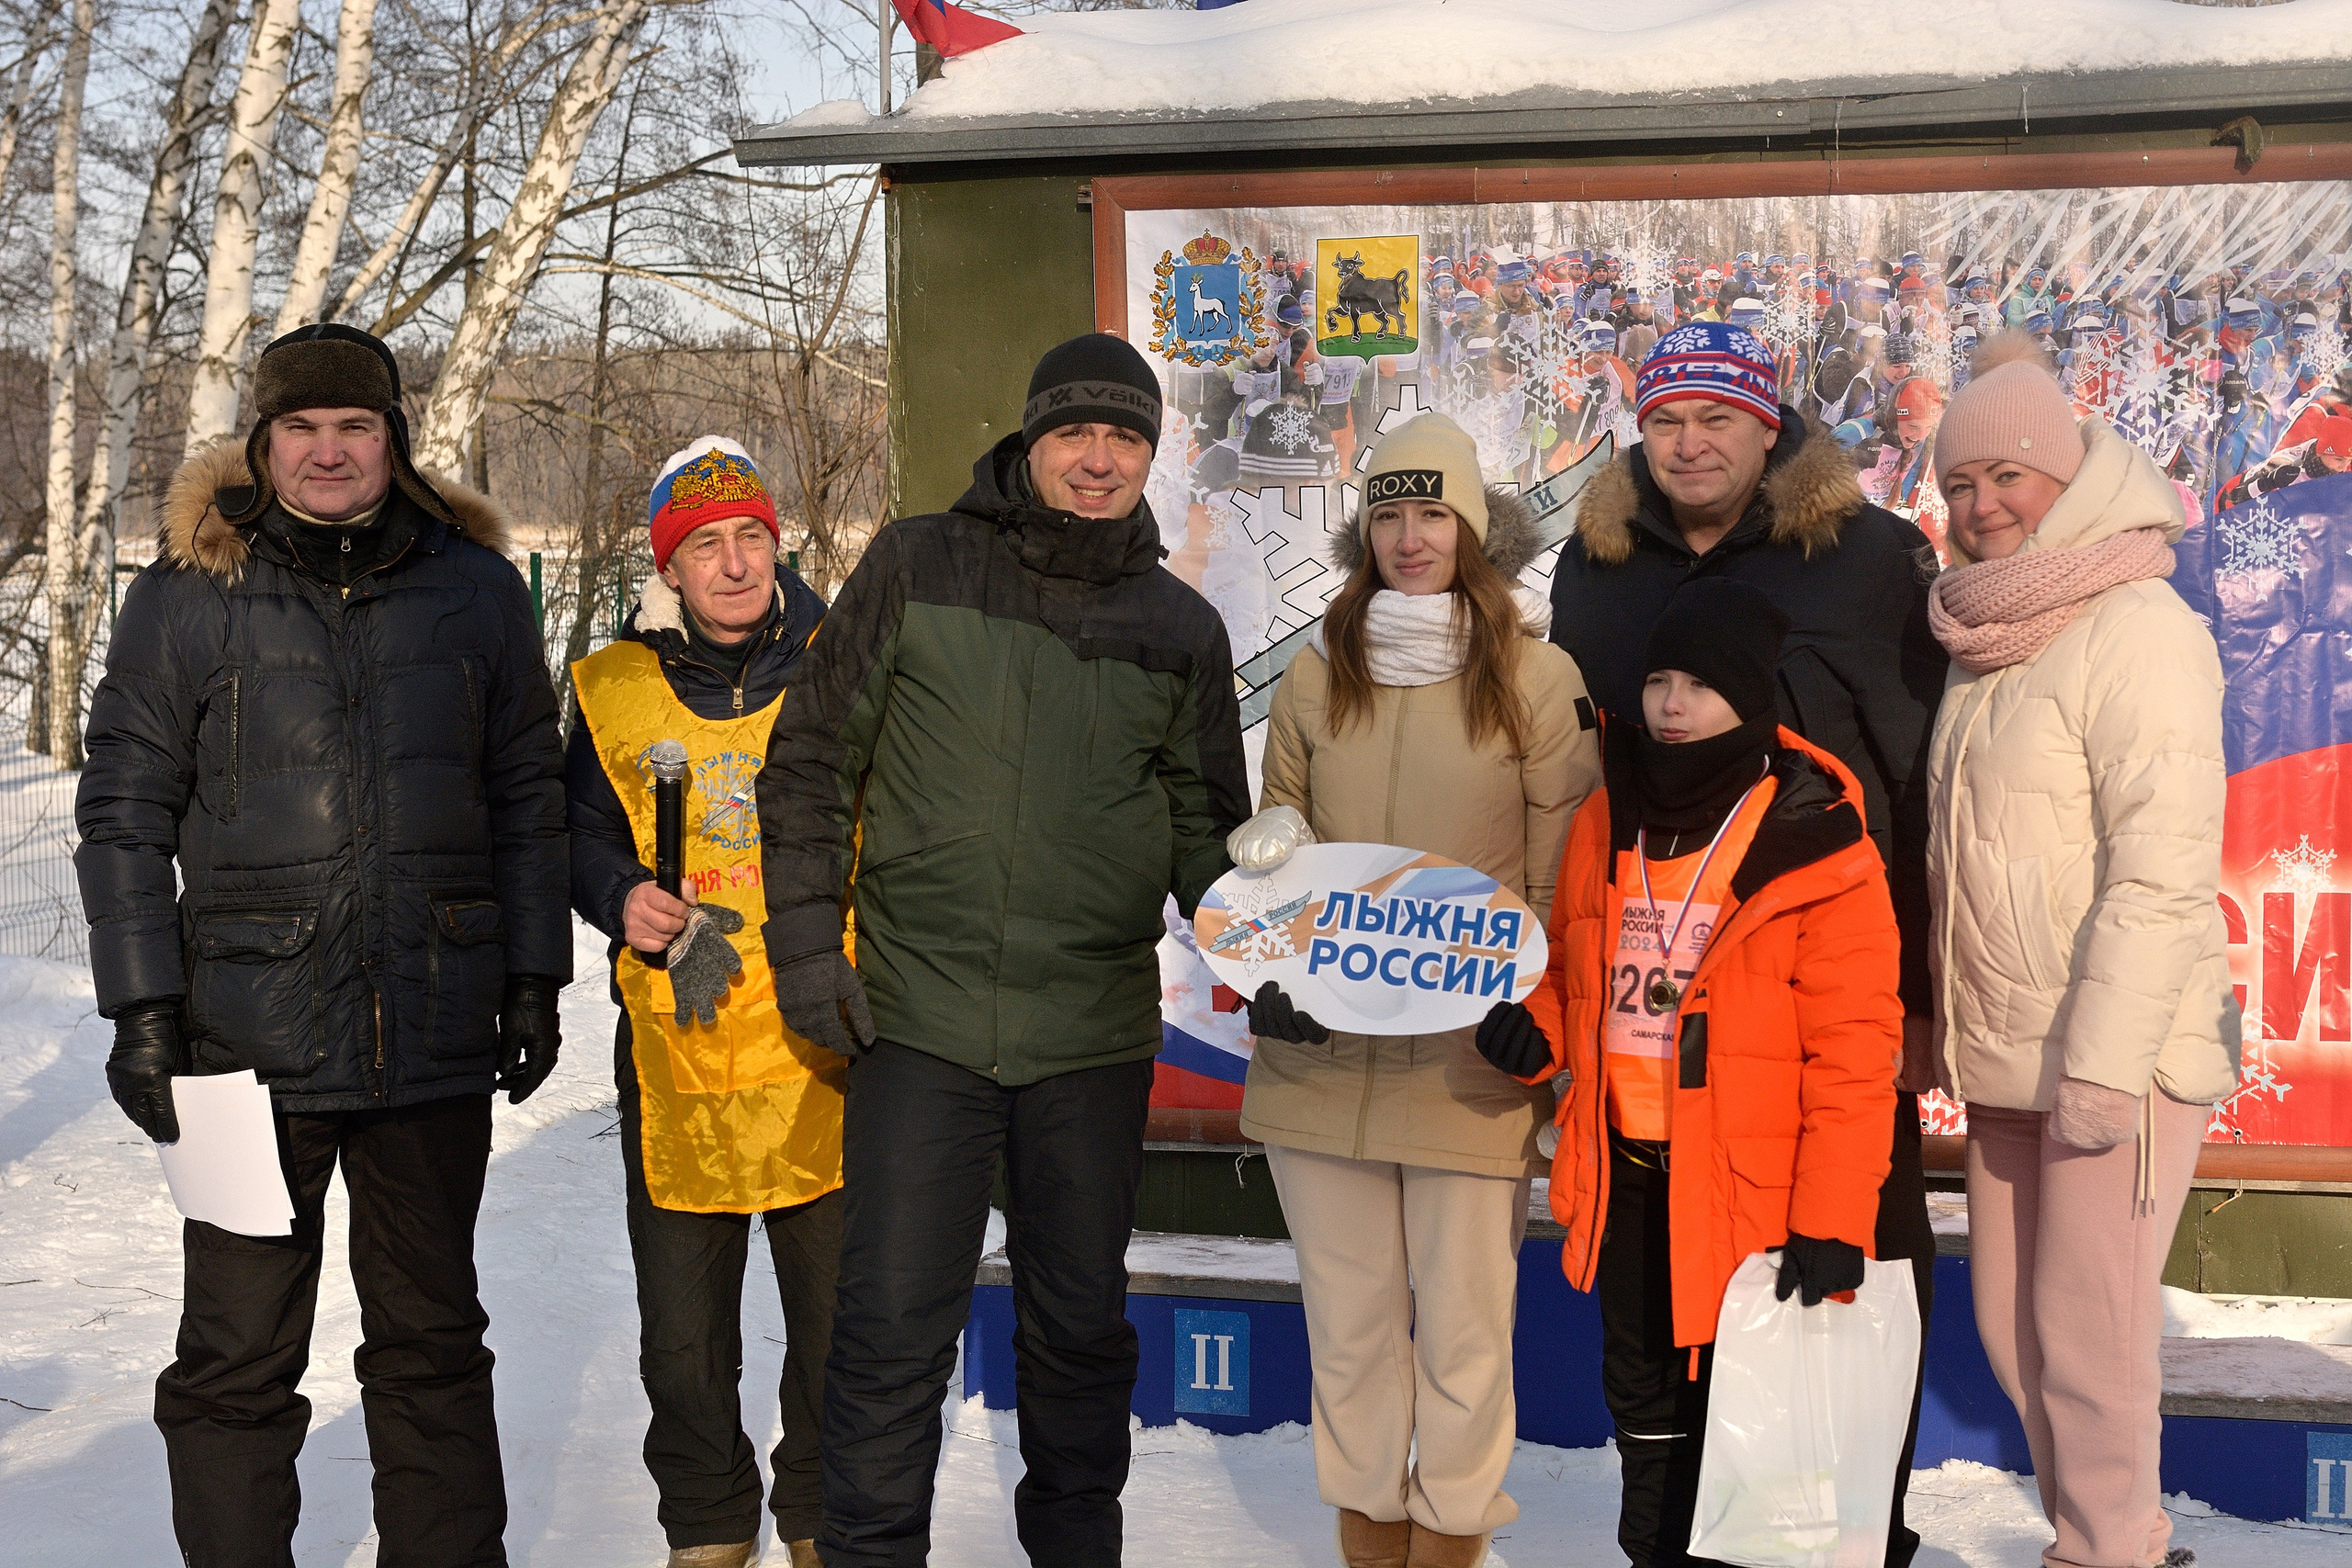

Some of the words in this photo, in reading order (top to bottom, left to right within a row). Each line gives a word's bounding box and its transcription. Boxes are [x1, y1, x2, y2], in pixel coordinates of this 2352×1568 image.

[1370, 474, 1438, 501] ROXY
[695, 750, 762, 778] ЛЫЖНЯ
[710, 831, 763, 851] РОССИ
[1268, 901, 1298, 919] РОССИИ
[1317, 891, 1522, 951] ЛЫЖНЯ
[1225, 931, 1250, 947] ЛЫЖНЯ
[1307, 939, 1518, 999] РОССИИ
[1191, 1334, 1234, 1391] II
